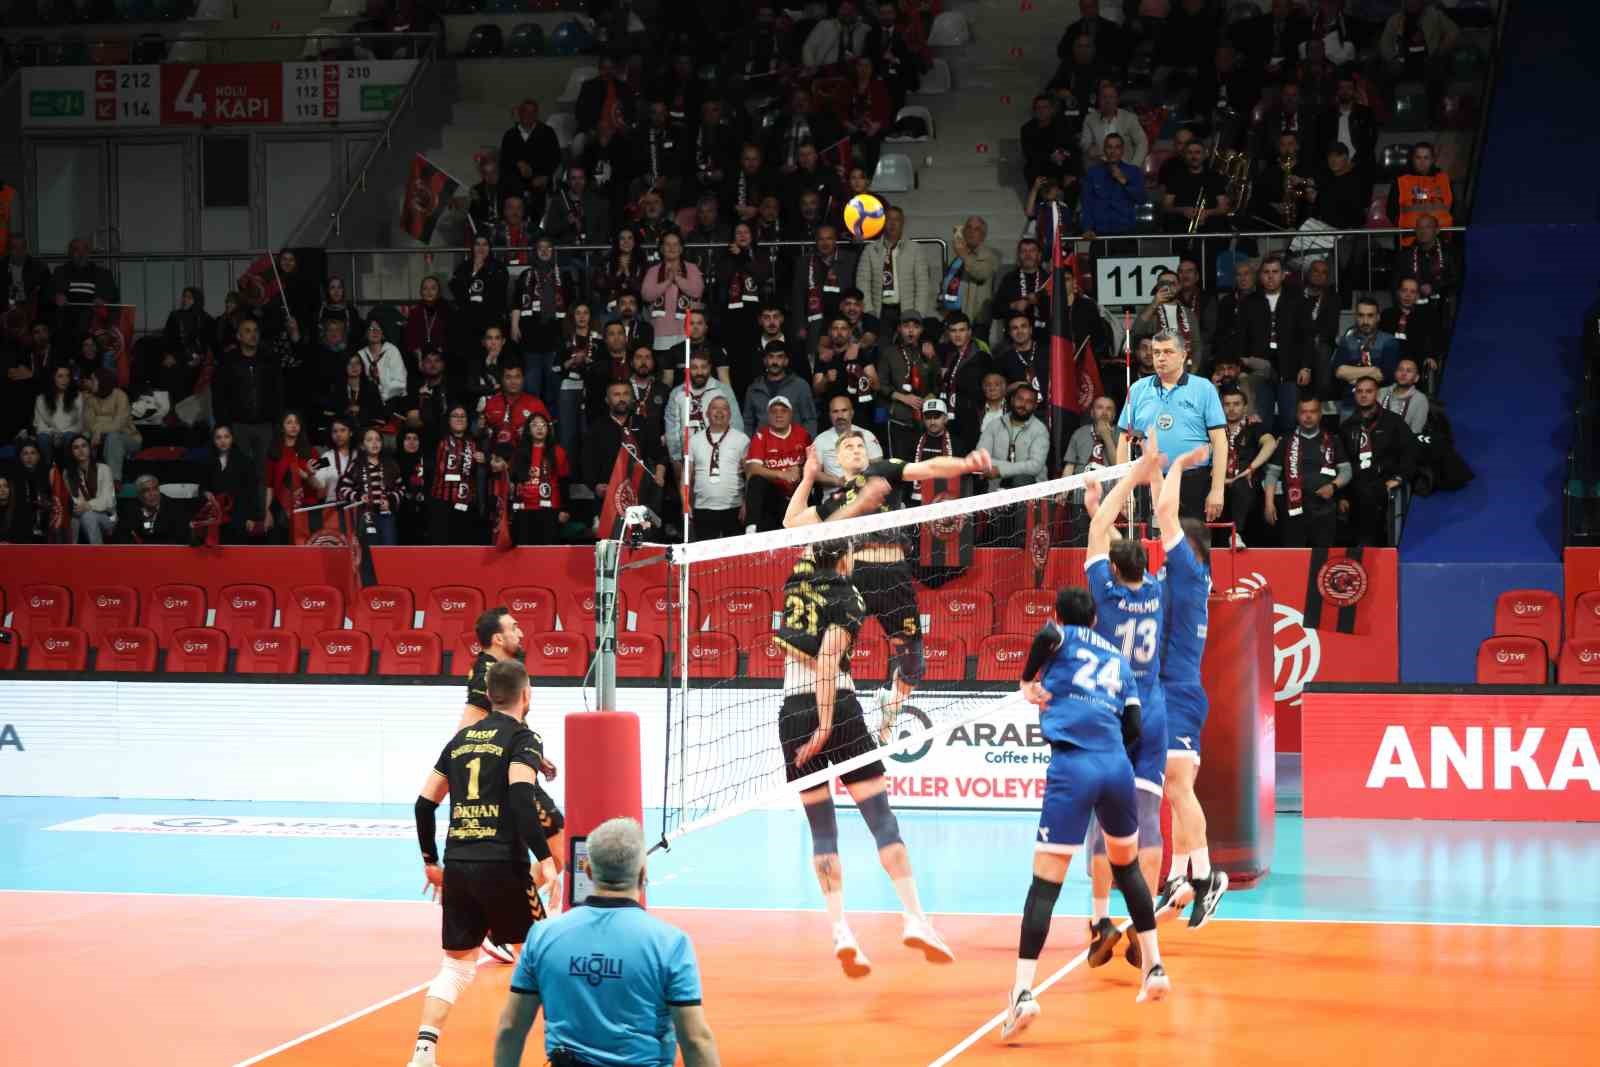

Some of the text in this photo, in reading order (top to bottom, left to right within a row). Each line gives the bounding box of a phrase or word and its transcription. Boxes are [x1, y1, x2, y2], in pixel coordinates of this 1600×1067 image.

[121, 72, 151, 89] 212
[296, 68, 318, 80] 211
[347, 67, 370, 79] 210
[174, 68, 207, 119] 4
[296, 86, 318, 97] 112
[122, 100, 151, 116] 114
[215, 97, 269, 119] KAPI
[296, 104, 318, 116] 113
[785, 593, 818, 636] 21
[903, 618, 916, 635] 5
[1114, 617, 1158, 664] 13
[1072, 647, 1123, 699] 24
[985, 751, 1029, 764] Coffee
[1365, 724, 1600, 791] ANKA
[465, 757, 480, 800] 1
